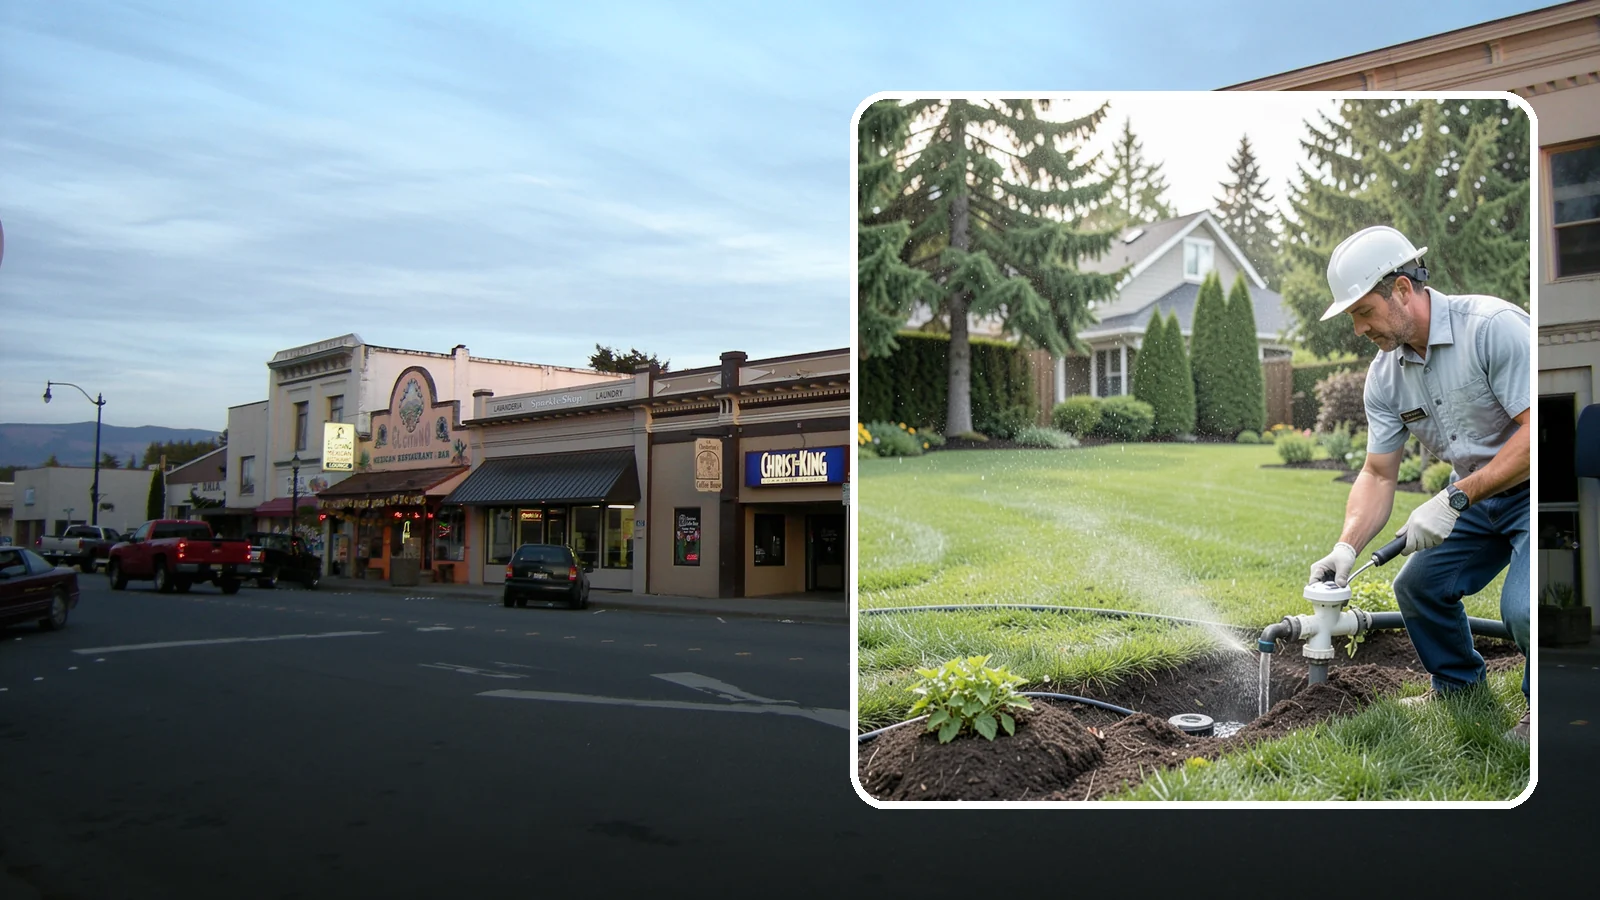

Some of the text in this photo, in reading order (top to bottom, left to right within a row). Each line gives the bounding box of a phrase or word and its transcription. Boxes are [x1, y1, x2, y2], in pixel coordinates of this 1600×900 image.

[493, 389, 623, 413] LAVANDERIA Sparkle Shop LAUNDRY
[373, 454, 396, 464] MEXICAN
[397, 451, 433, 462] RESTAURANT
[438, 450, 450, 459] BAR
[760, 449, 828, 478] CHRIST KING
